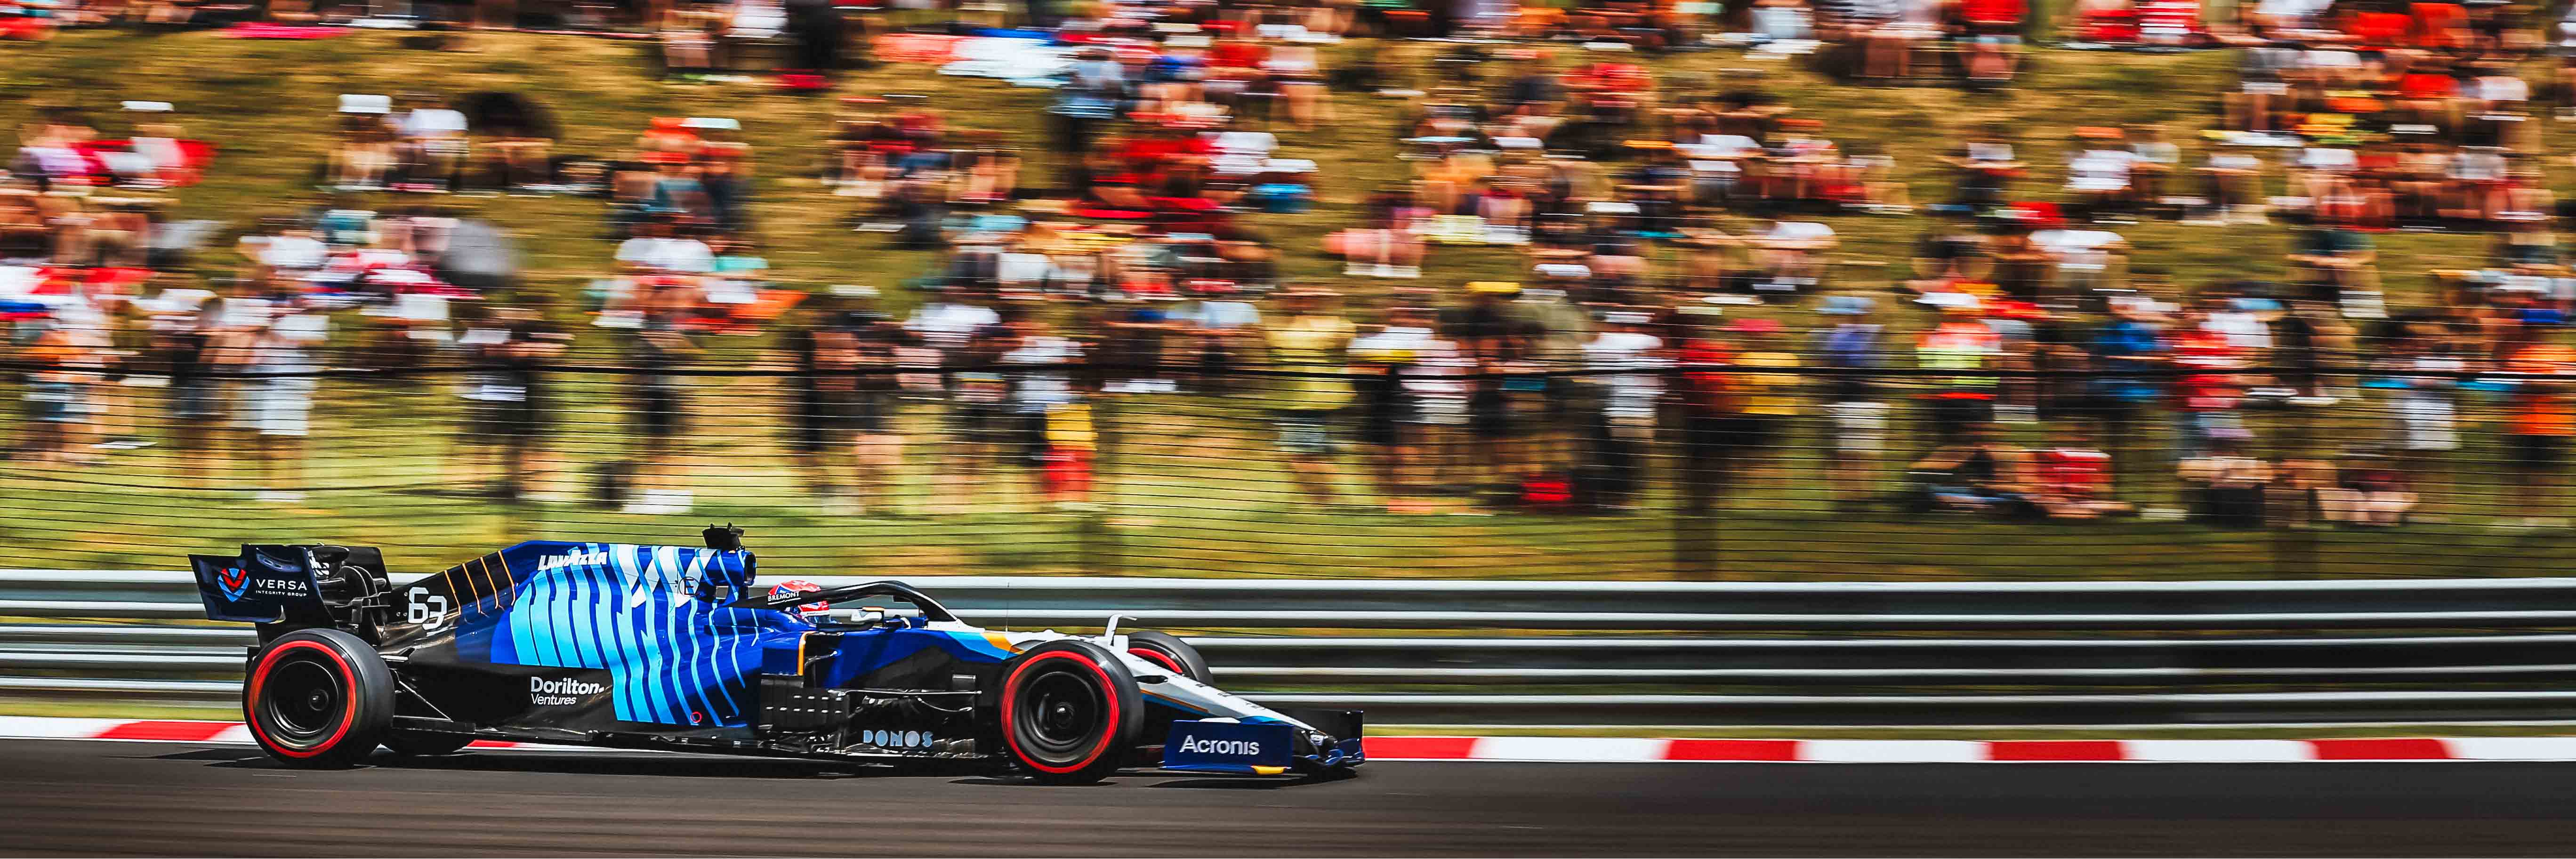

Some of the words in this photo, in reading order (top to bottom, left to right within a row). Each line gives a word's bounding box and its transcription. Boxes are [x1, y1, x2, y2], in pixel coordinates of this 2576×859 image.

[538, 549, 608, 570] LAVAZZA
[256, 578, 307, 591] VERSA
[768, 591, 800, 602] BREMONT
[408, 587, 447, 630] 63
[531, 676, 600, 695] Dorilton
[531, 693, 577, 705] Ventures
[1179, 735, 1260, 755] Acronis
